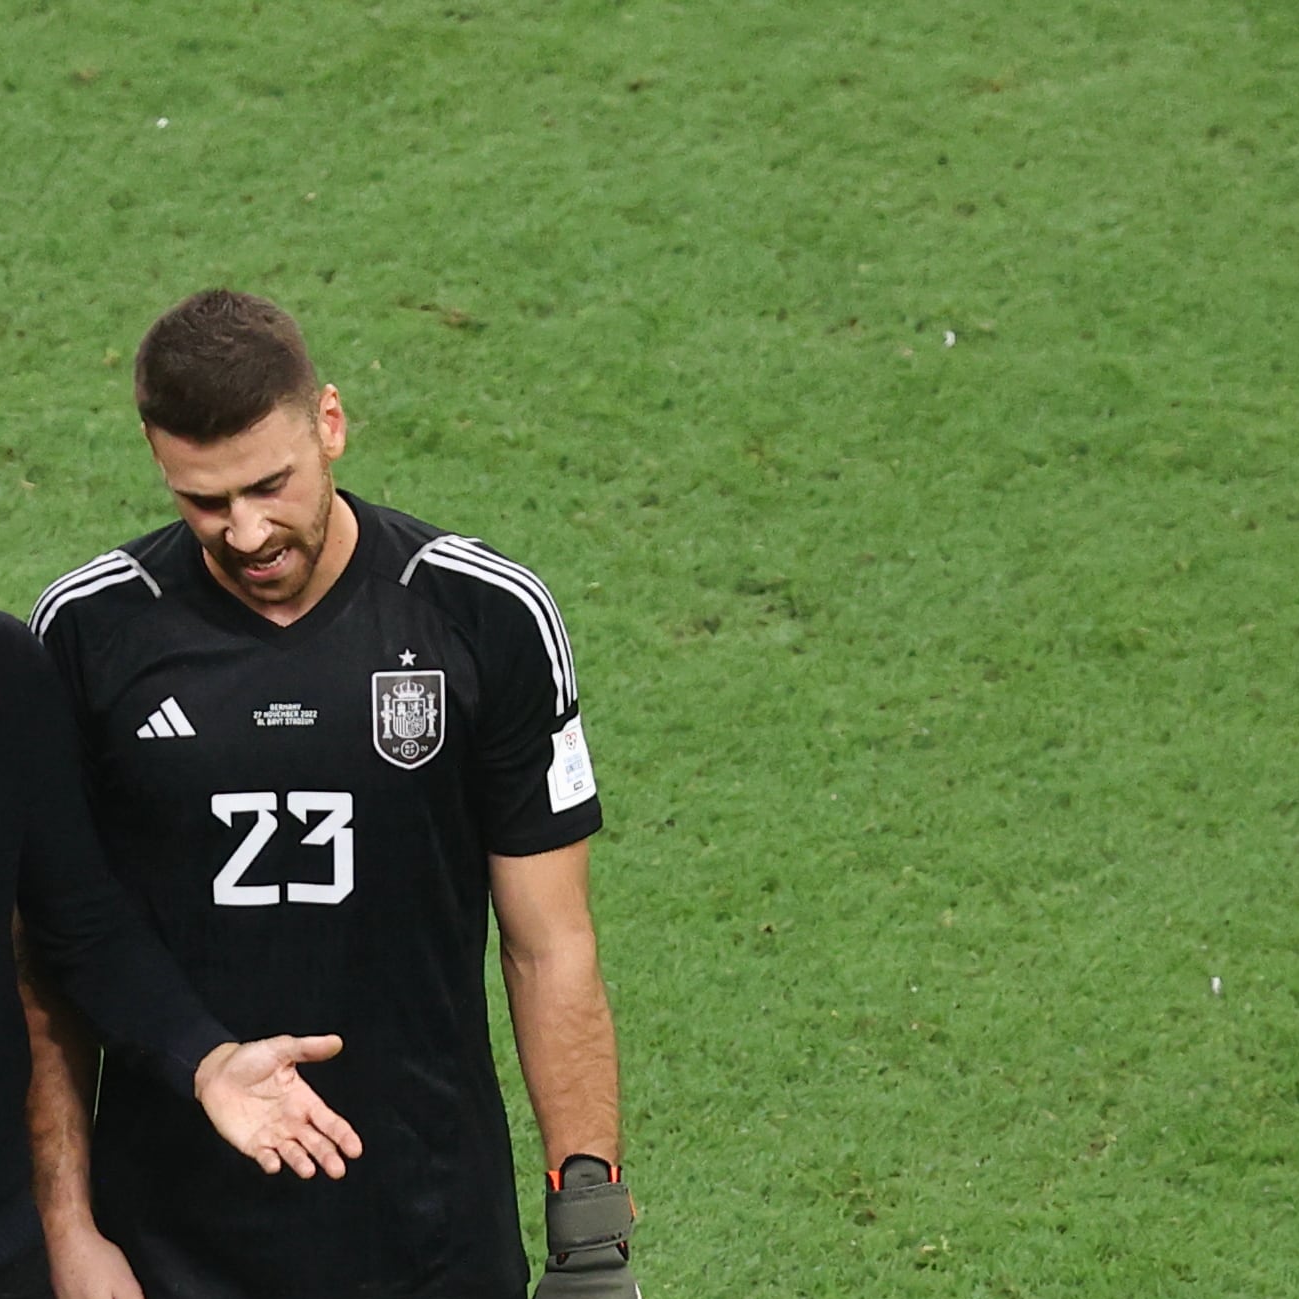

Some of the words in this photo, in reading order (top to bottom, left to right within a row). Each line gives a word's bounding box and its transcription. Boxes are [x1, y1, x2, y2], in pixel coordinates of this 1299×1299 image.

[269, 703, 302, 711] GERMANY
[253, 711, 262, 719] 27
[300, 710, 318, 718] 2022
[211, 791, 354, 906] 23
